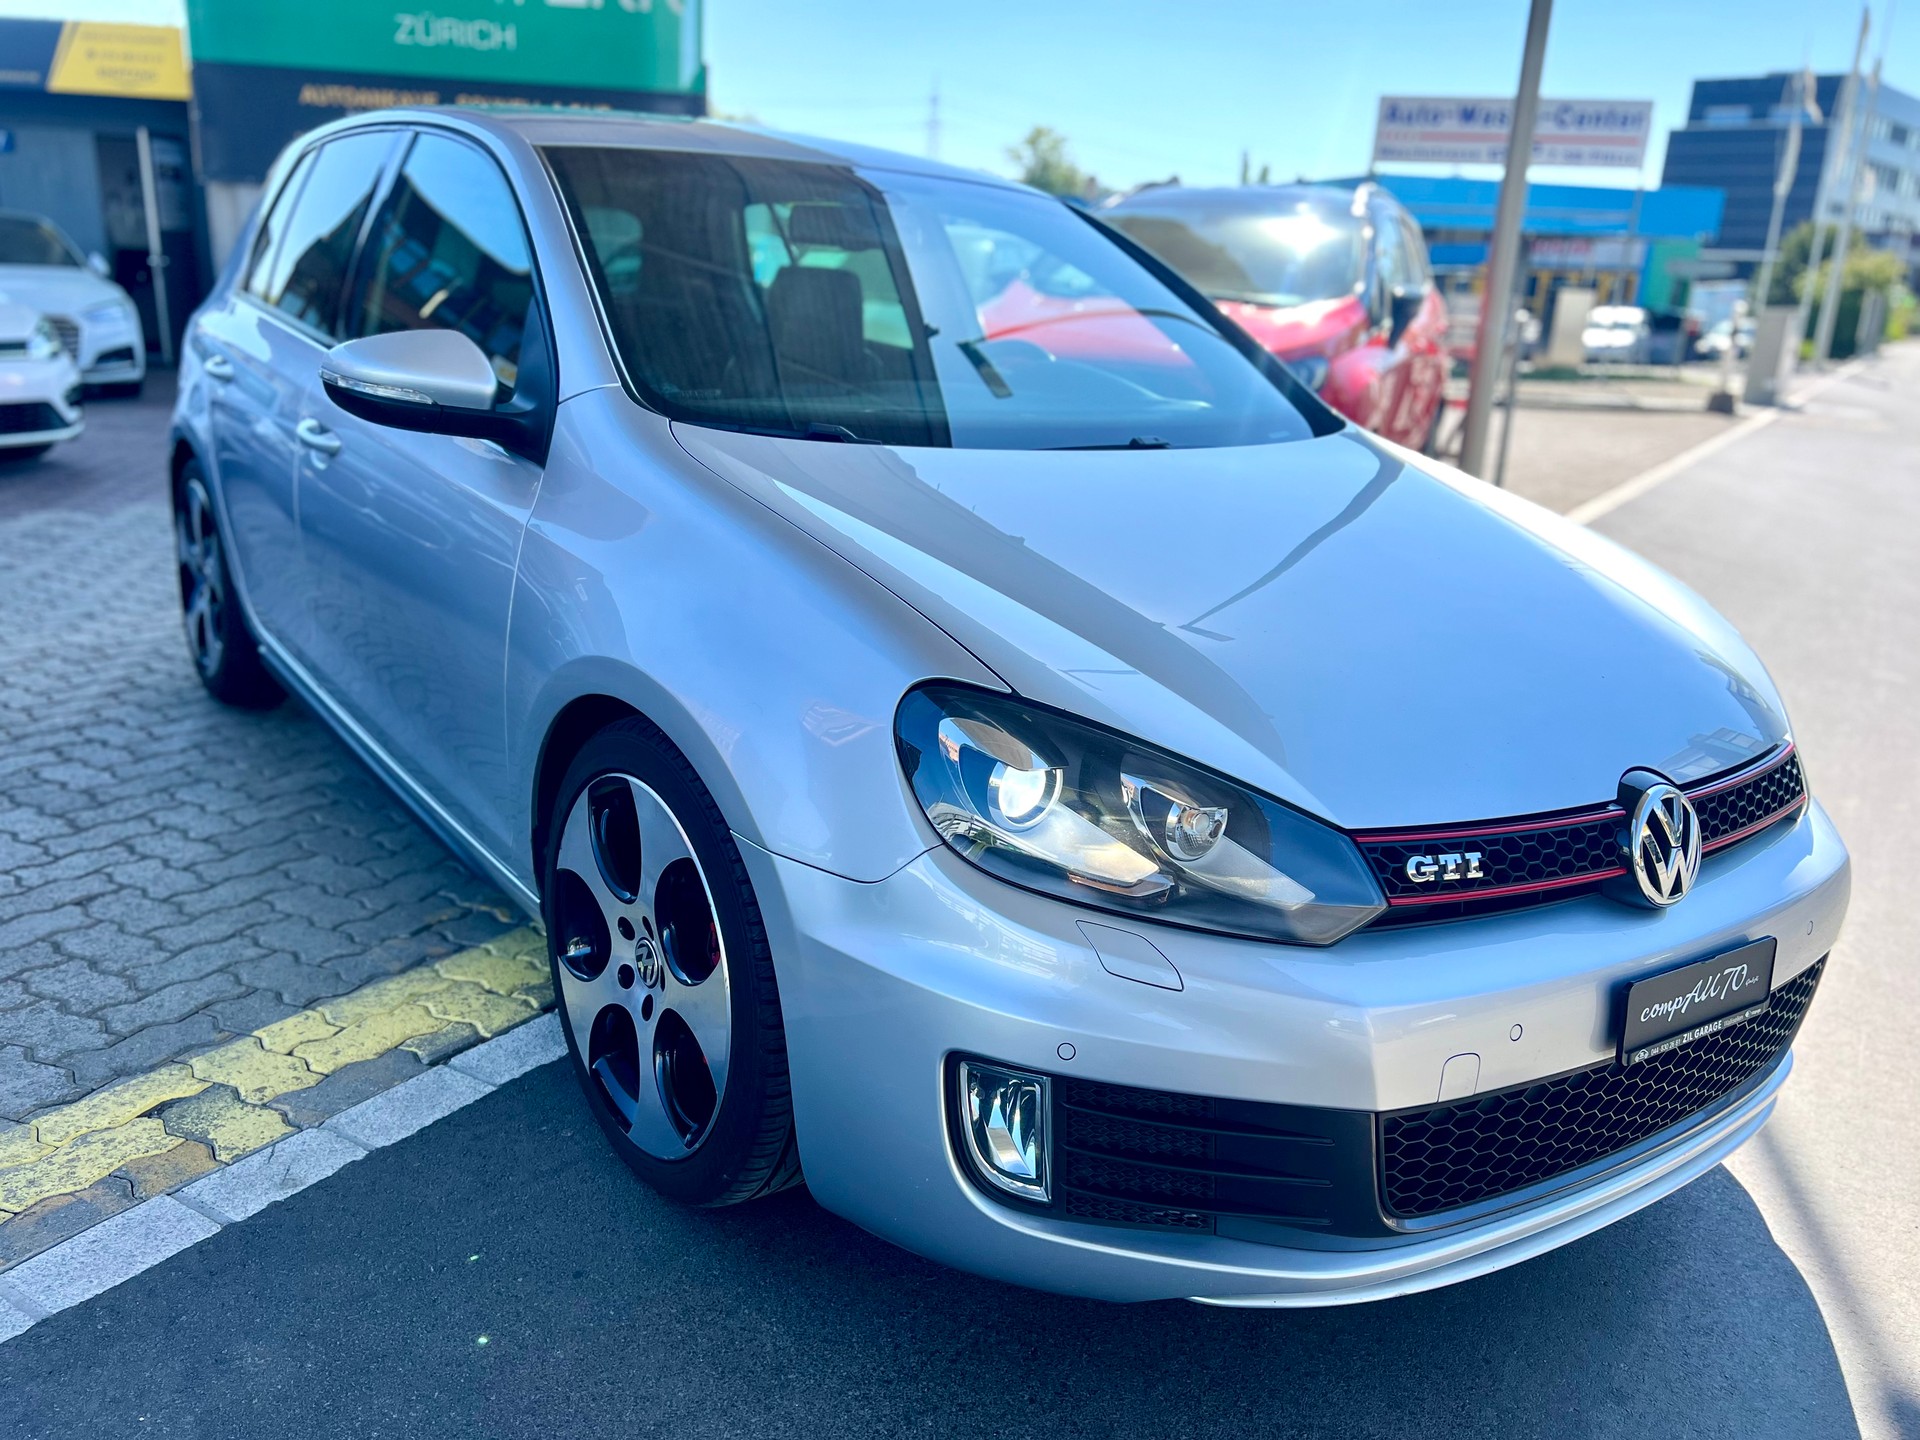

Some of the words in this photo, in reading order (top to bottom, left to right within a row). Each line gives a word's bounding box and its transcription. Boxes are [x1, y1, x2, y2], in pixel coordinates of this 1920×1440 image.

[393, 11, 517, 51] ZÜRICH
[1406, 851, 1484, 882] GTI
[1682, 1031, 1693, 1043] ZIL
[1694, 1020, 1722, 1038] GARAGE
